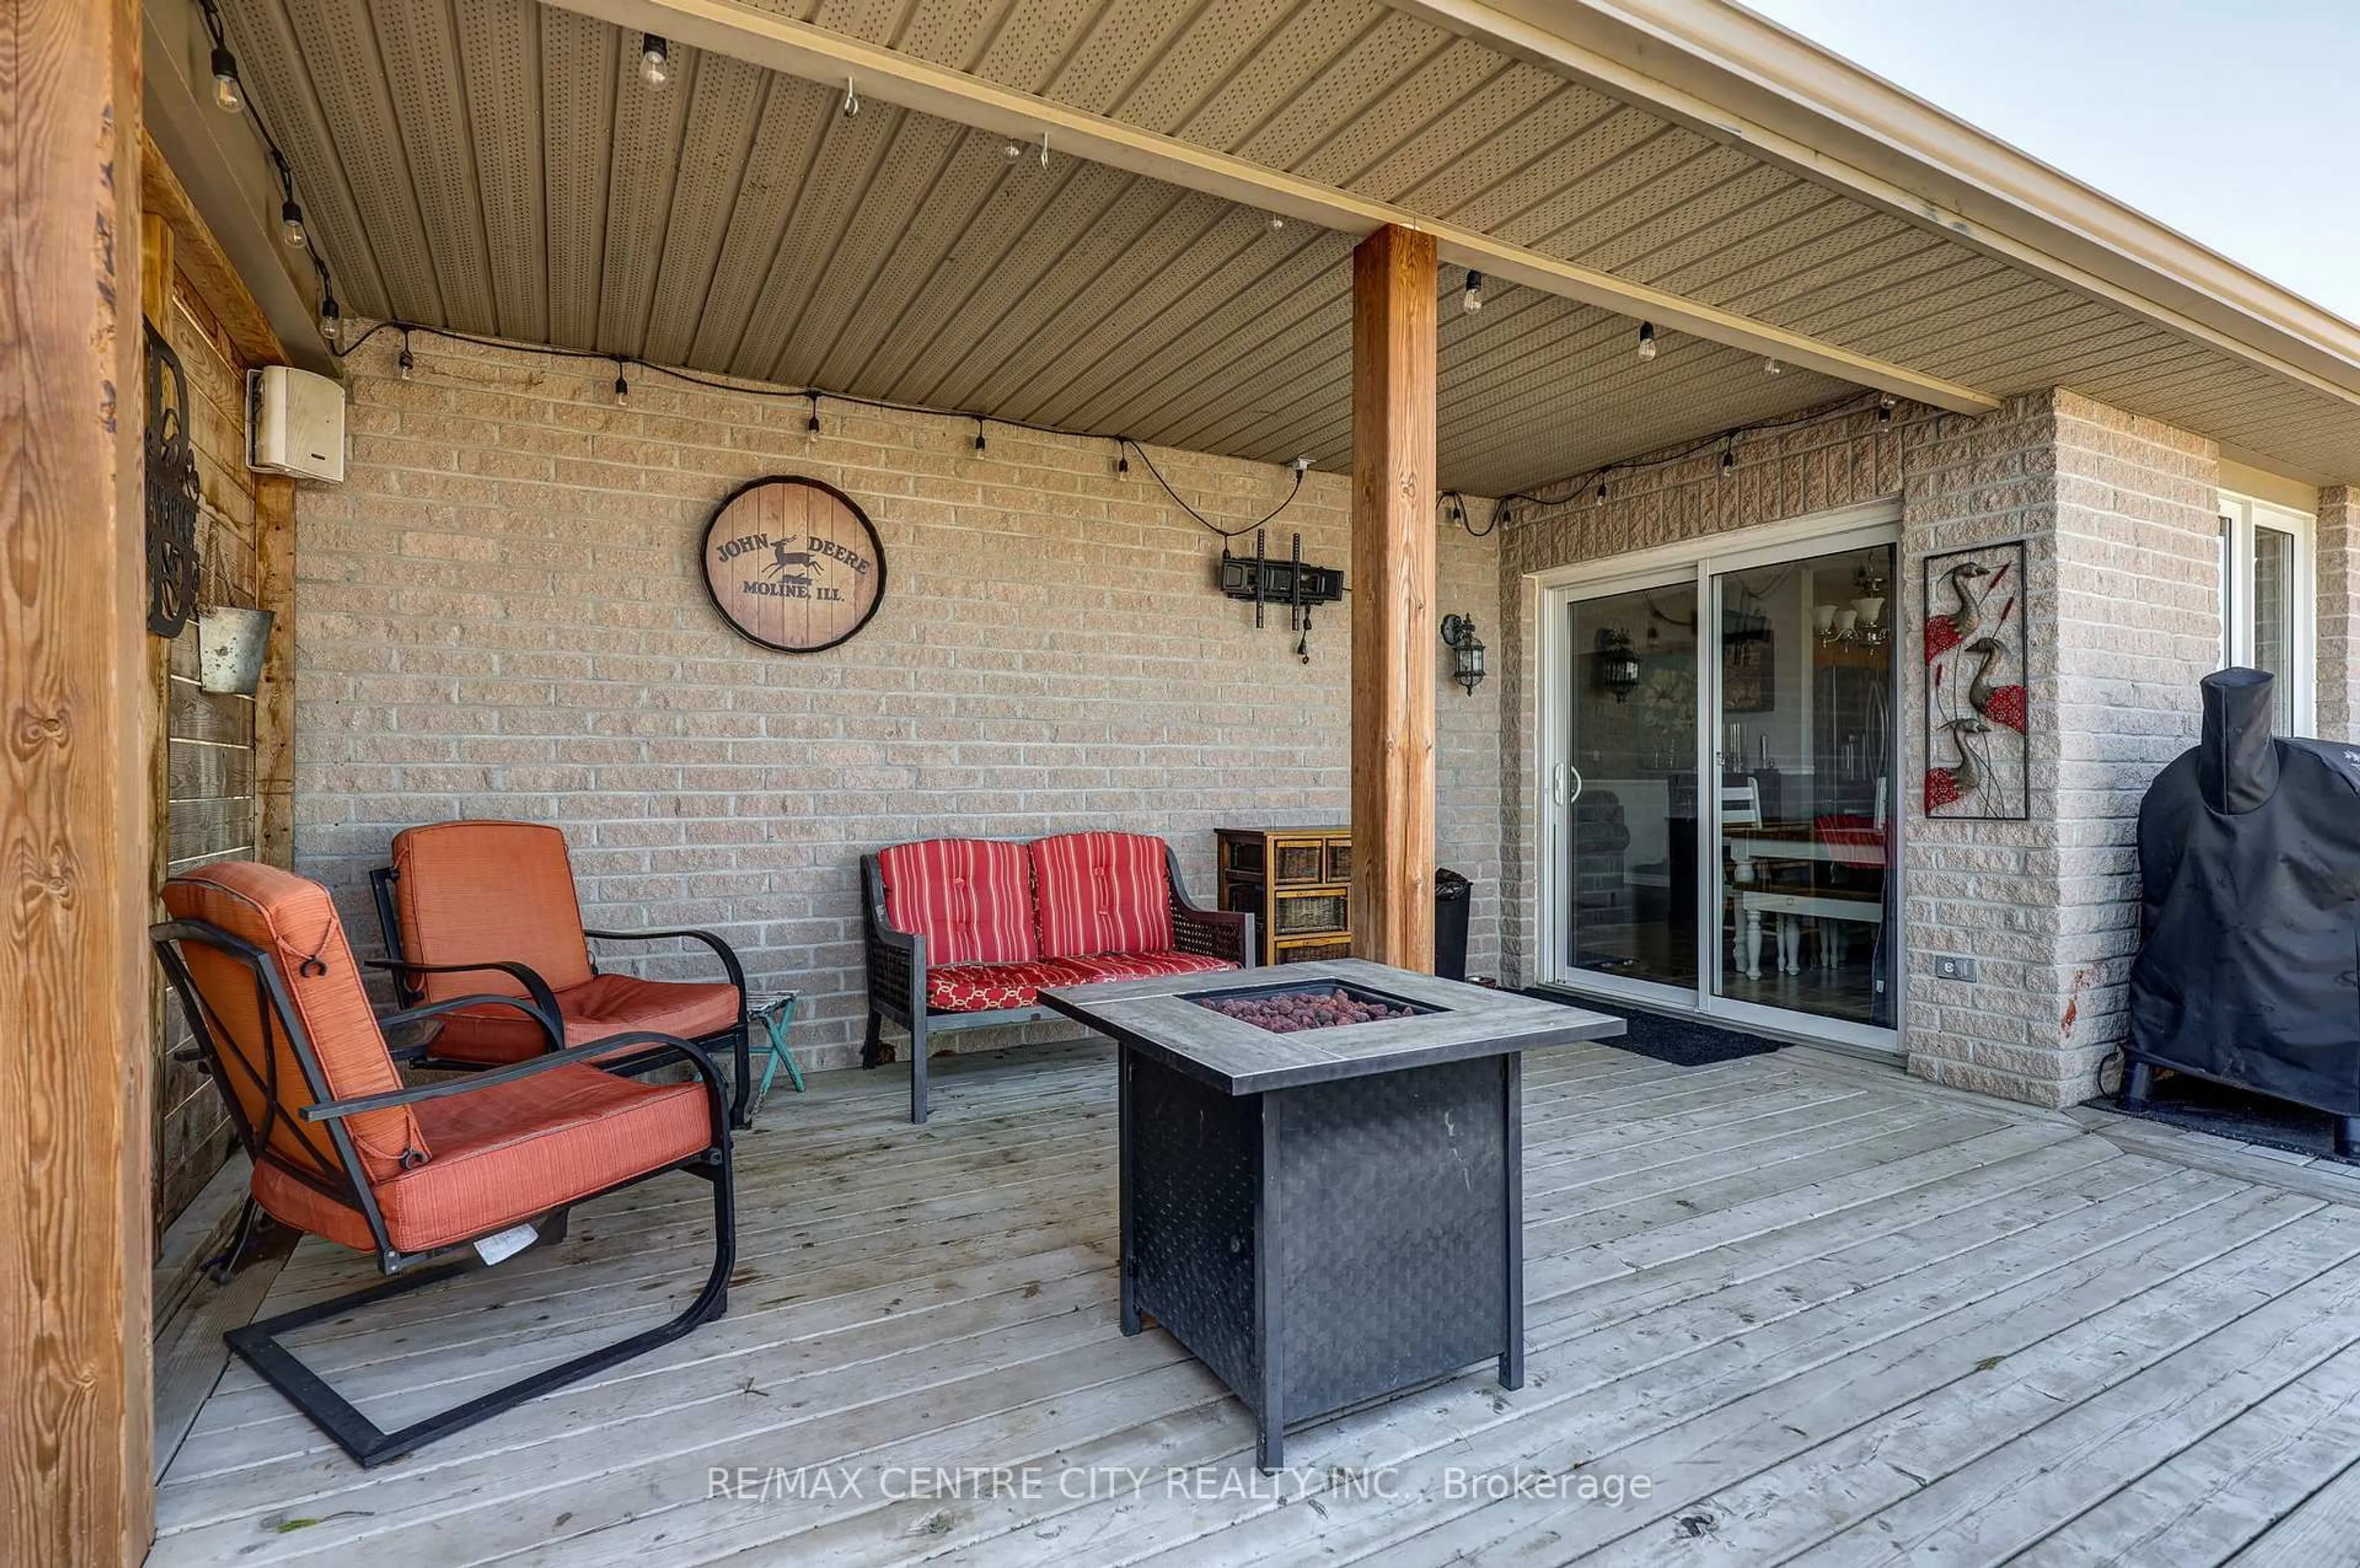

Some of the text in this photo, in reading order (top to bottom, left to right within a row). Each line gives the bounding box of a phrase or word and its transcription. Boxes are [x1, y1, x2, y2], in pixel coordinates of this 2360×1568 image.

[716, 533, 870, 574] JOHN DEERE
[744, 581, 845, 602] MOLINE, ILL.
